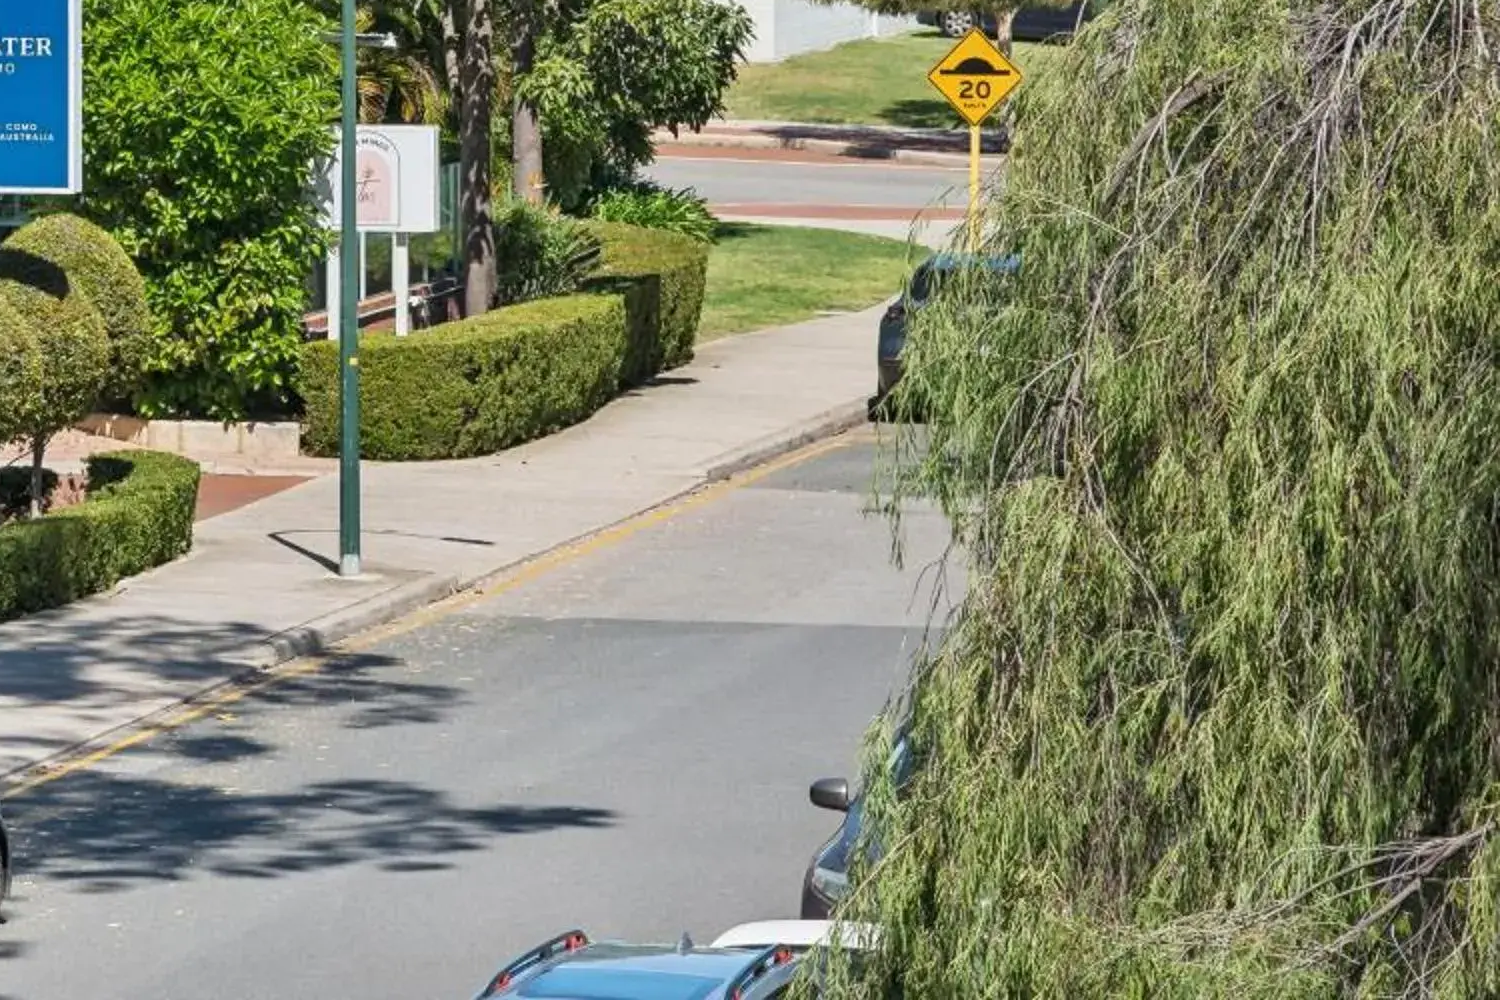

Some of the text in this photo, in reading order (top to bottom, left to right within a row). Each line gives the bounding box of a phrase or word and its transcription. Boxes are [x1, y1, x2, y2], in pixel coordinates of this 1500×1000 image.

[959, 80, 991, 99] 20
[5, 122, 37, 131] COMO
[0, 132, 54, 142] AUSTRALIA
